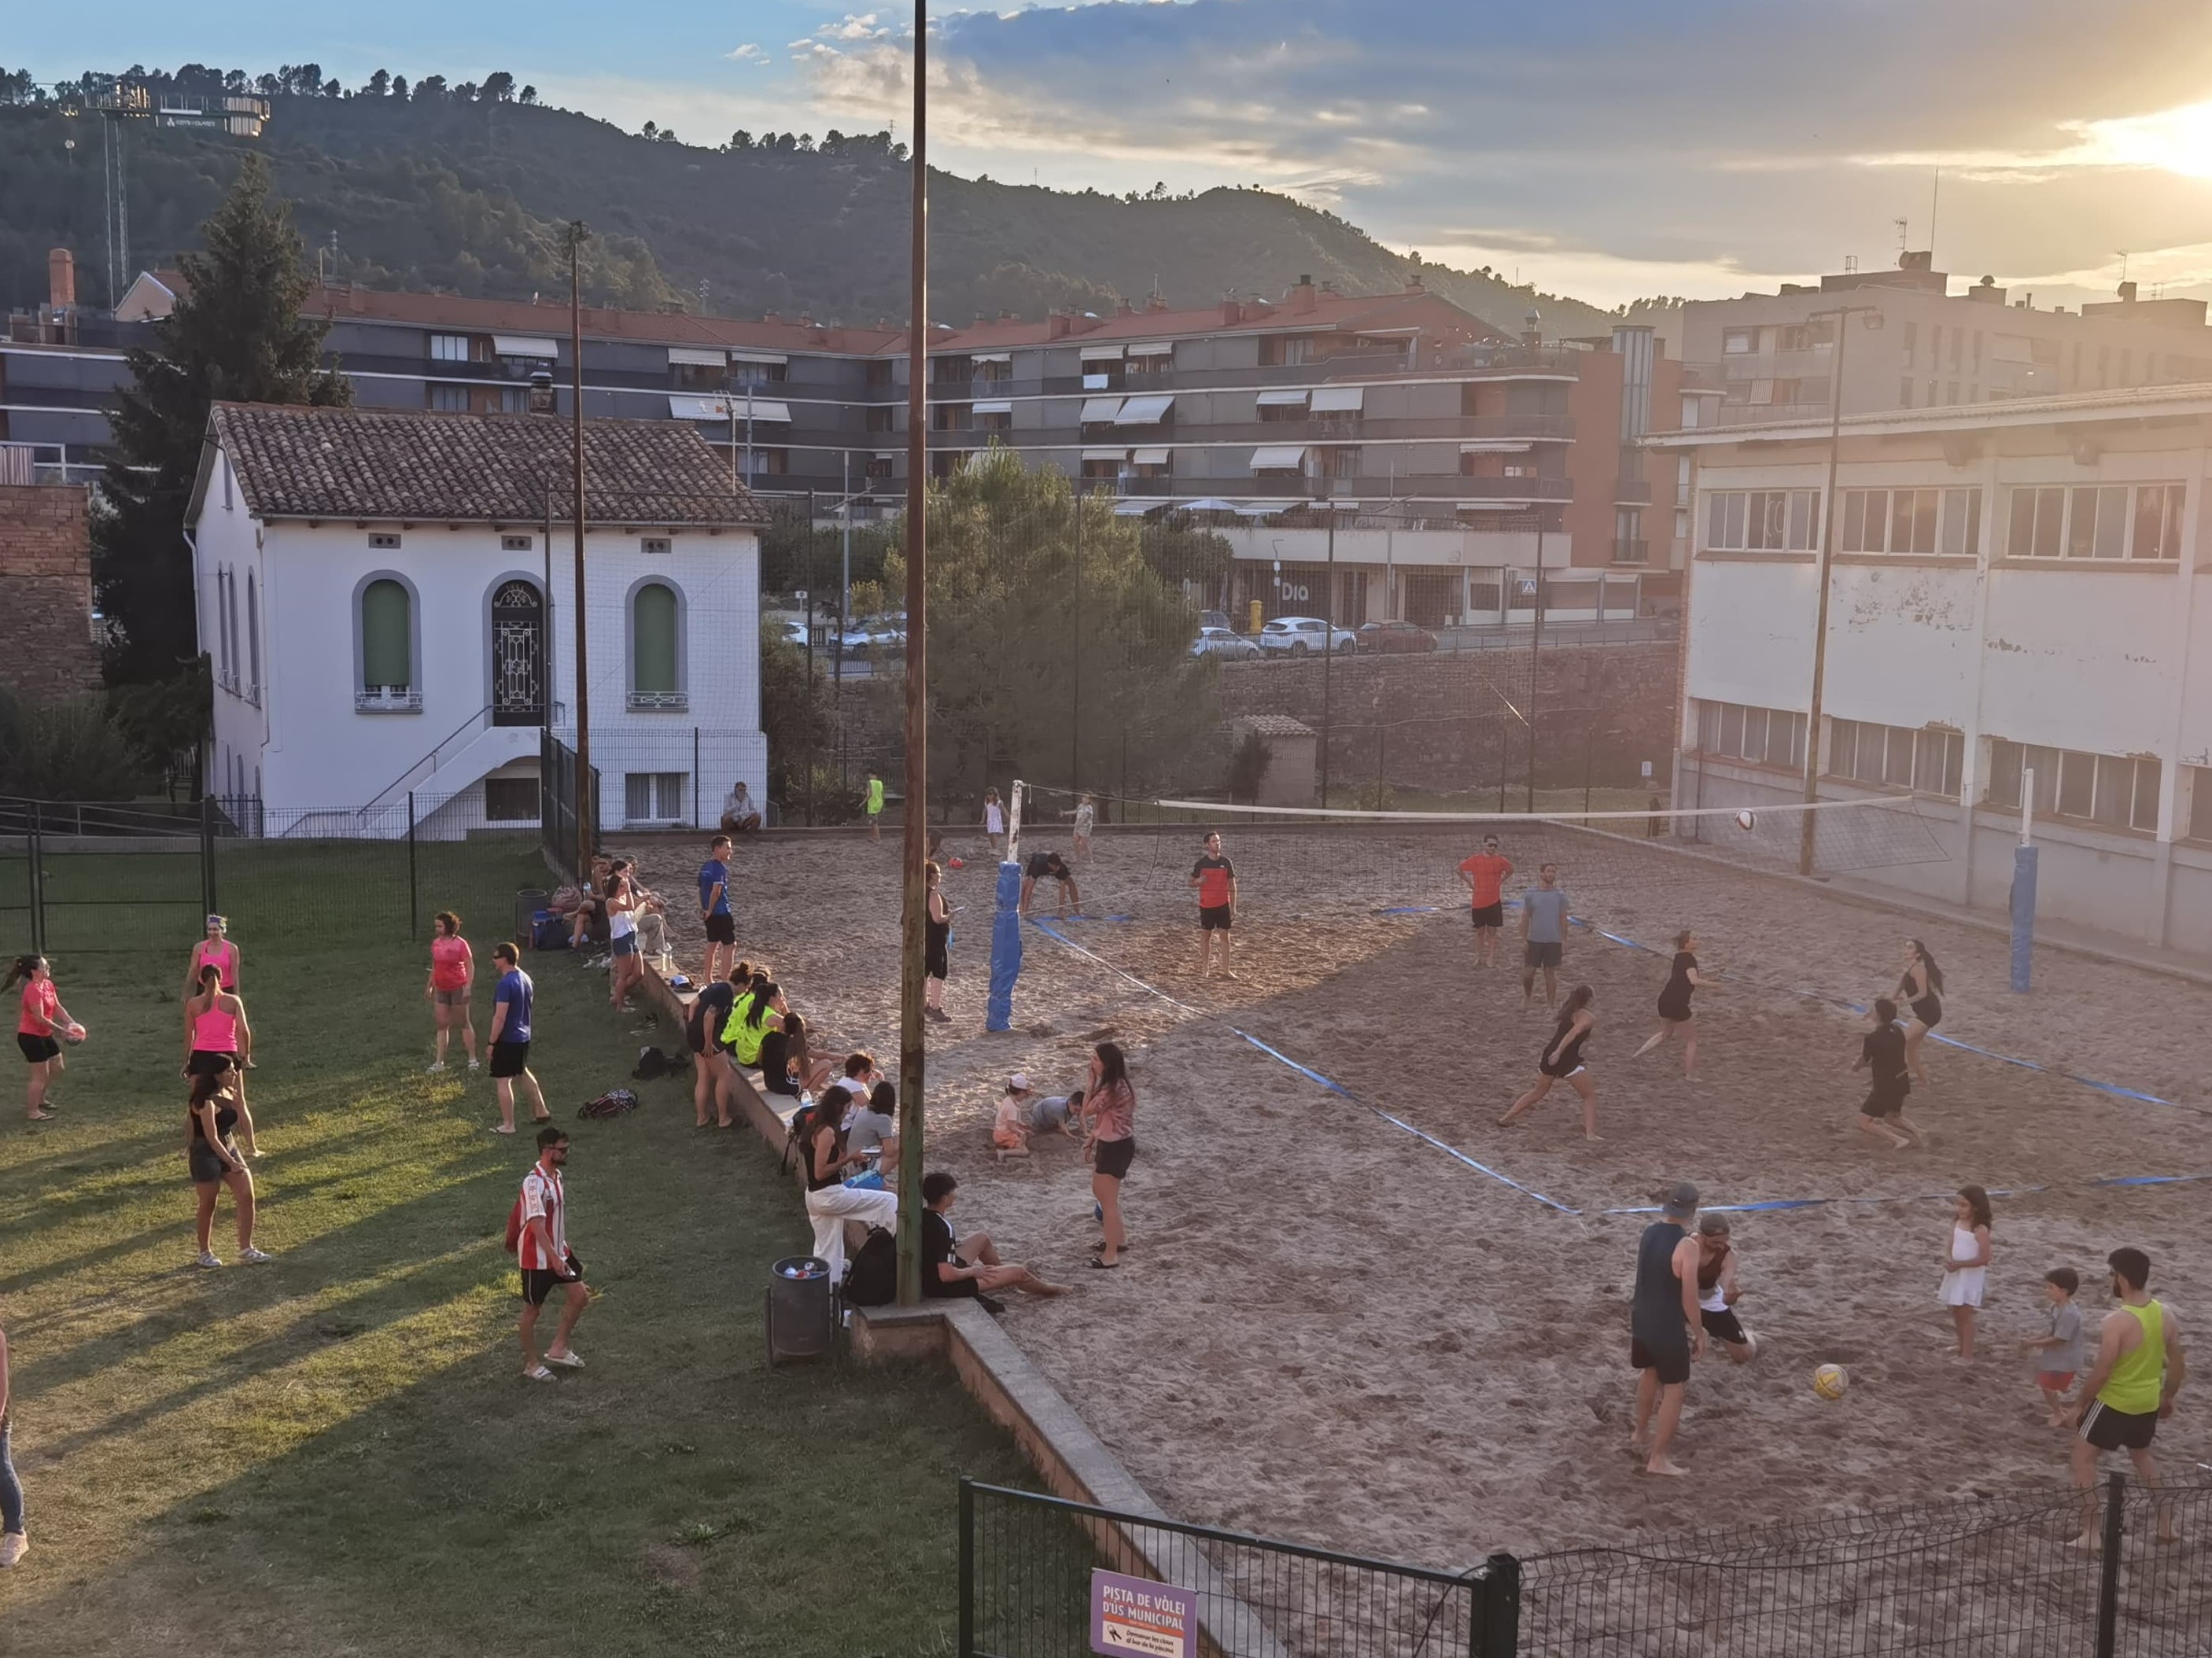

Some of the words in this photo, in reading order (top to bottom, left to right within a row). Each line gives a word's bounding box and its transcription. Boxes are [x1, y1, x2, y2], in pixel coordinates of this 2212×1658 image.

[1103, 1585, 1134, 1604] PISTA
[1137, 1593, 1151, 1607] DE
[1154, 1595, 1185, 1616] VÒLEI
[1103, 1600, 1124, 1616] D'ÚS
[1128, 1607, 1185, 1630] MUNICIPAL
